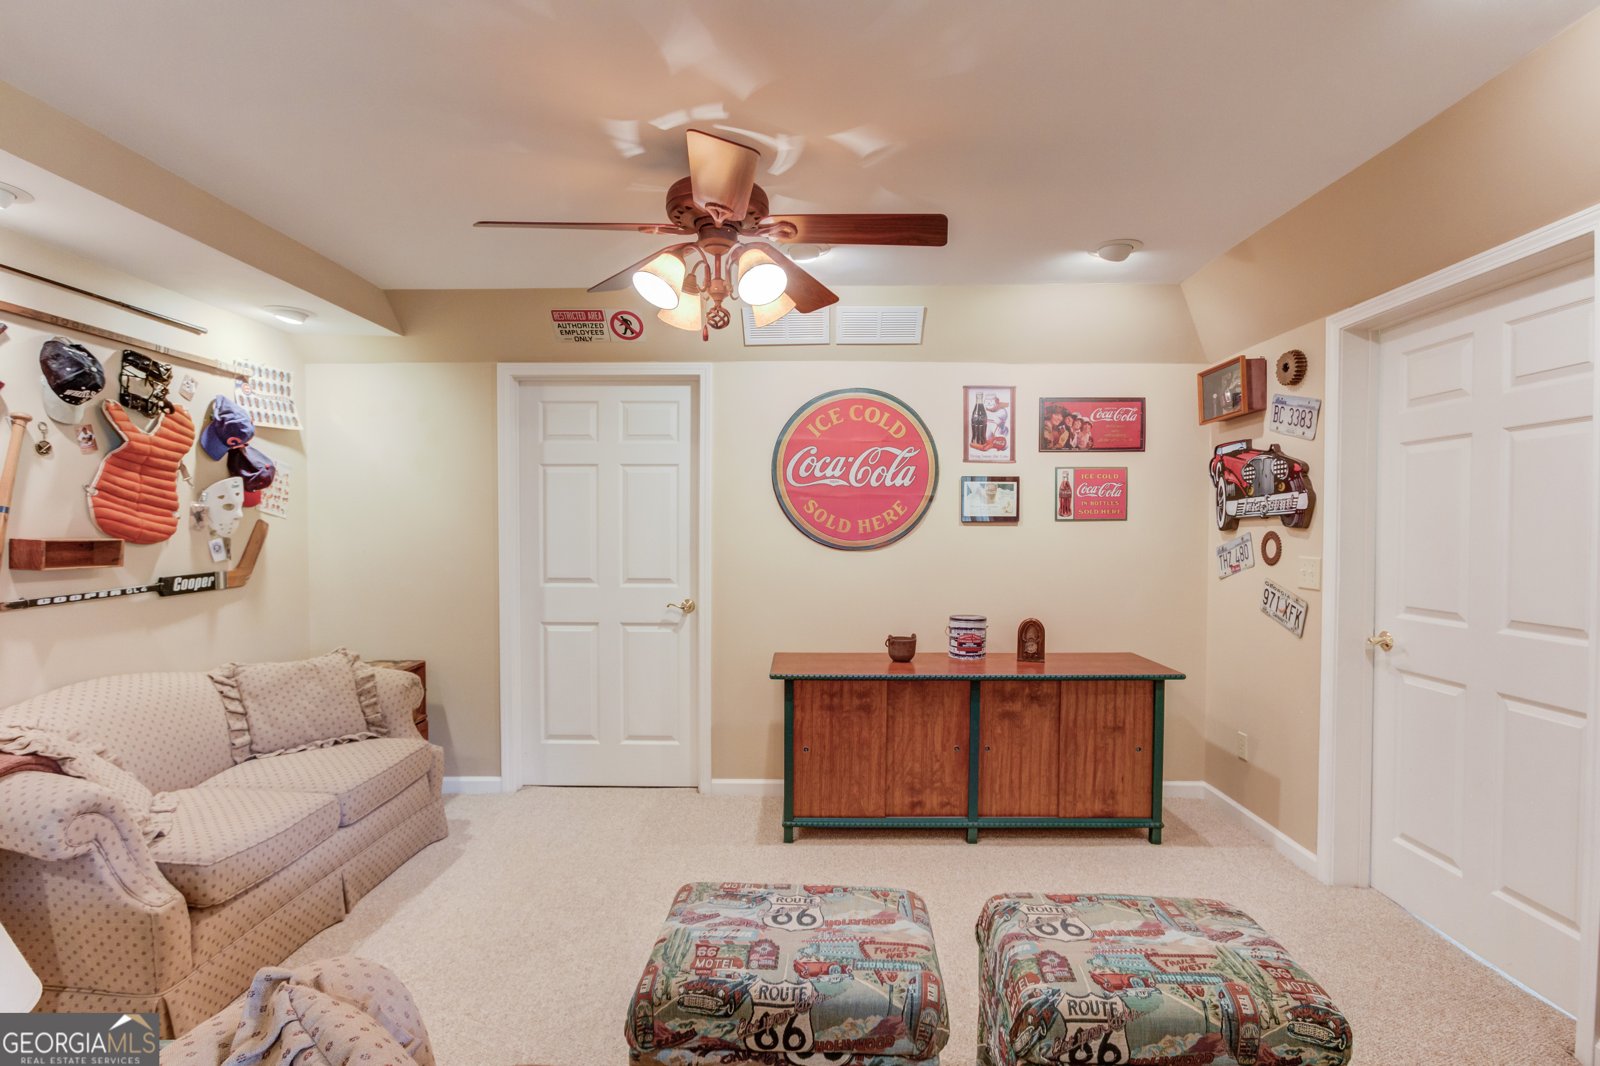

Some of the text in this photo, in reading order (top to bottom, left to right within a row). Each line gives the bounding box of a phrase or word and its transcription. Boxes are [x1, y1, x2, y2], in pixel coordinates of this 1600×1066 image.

[553, 312, 602, 321] RESTRICTED AREA
[806, 404, 907, 439] ICE COLD
[1090, 407, 1138, 422] Coca-Cola
[1273, 405, 1313, 429] BC 3383
[786, 446, 920, 487] Coca-Cola
[1076, 482, 1123, 497] Coca-Cola
[803, 499, 908, 534] SOLD HERE
[1235, 544, 1249, 562] 480
[173, 576, 215, 591] Cooper
[37, 590, 121, 605] COOPER
[1263, 588, 1302, 629] 971 XFK
[771, 907, 817, 926] 66
[1026, 905, 1067, 914] ROUTE
[1035, 917, 1085, 937] 66
[696, 946, 718, 957] 66
[694, 959, 738, 969] MOTEL
[759, 984, 808, 1002] ROUTE
[1280, 980, 1322, 995] MOTEL
[1067, 1000, 1118, 1018] ROUTE
[754, 1011, 806, 1051] 66
[815, 1035, 895, 1053] HOLLYWOOD
[1068, 1027, 1122, 1065] 66
